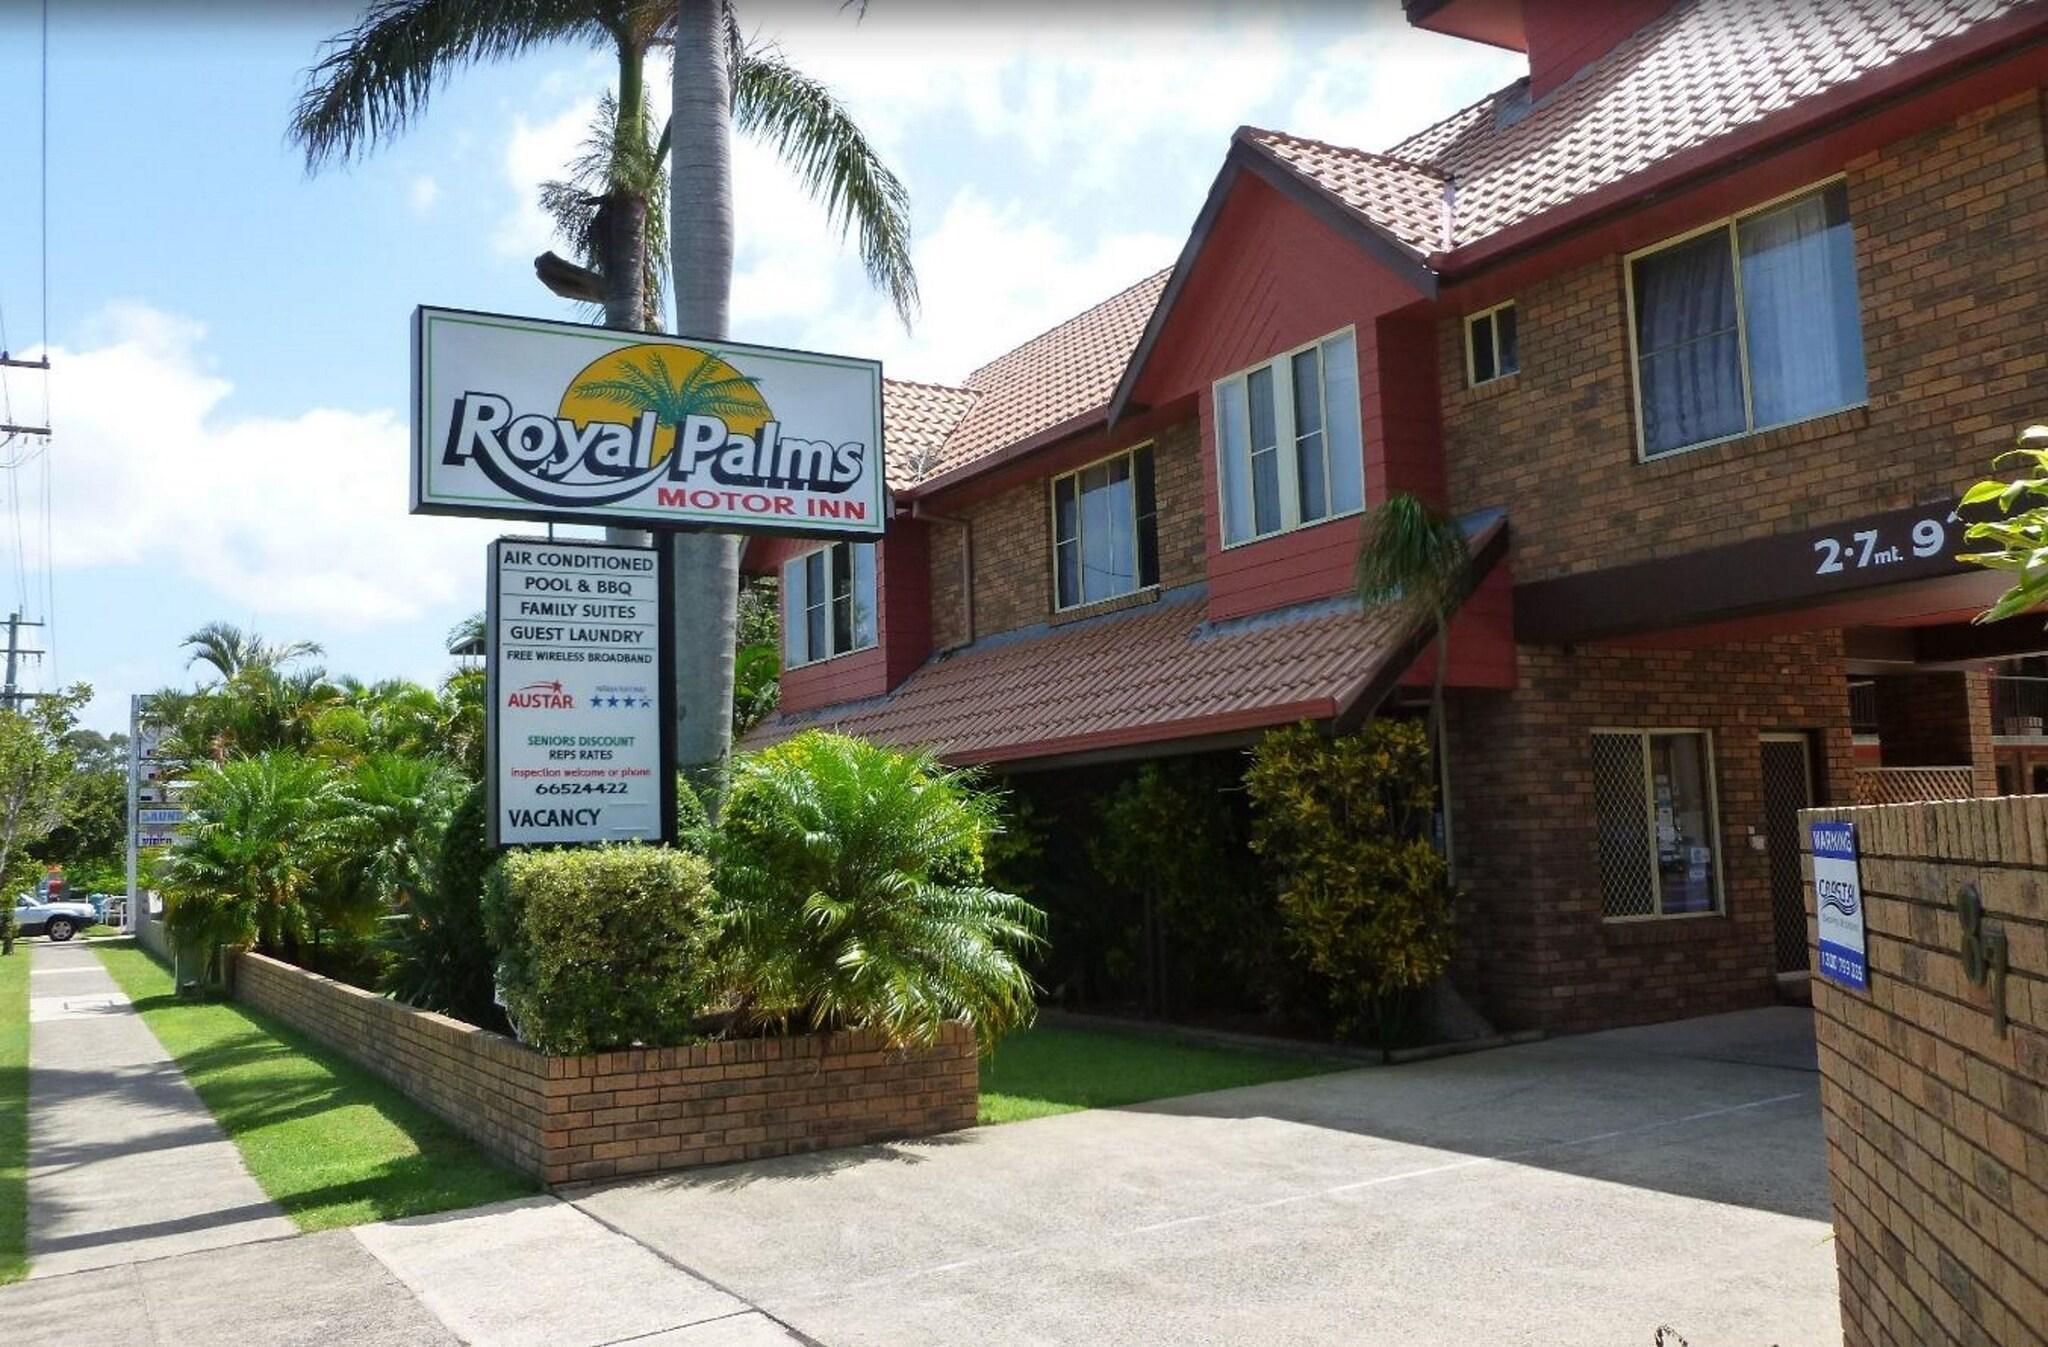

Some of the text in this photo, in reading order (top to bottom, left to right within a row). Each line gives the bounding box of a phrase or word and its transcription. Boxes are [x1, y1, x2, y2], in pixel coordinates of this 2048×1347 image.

[443, 391, 865, 505] Royal Palms
[658, 487, 866, 519] MOTOR INN
[504, 551, 653, 571] AIR CONDITIONED
[525, 577, 632, 596] POOL & BBQ
[521, 602, 636, 619] FAMILY SUITES
[511, 626, 644, 643] GUEST LAUNDRY
[507, 650, 652, 664] FREE WIRELESS BROADBAND
[508, 693, 574, 709] AUSTAR
[528, 736, 636, 747] SENIORS DISCOUNT
[549, 750, 613, 760] REPS RATES
[564, 767, 605, 777] welcome
[608, 769, 619, 777] or
[621, 767, 651, 778] phone
[508, 808, 602, 828] VACANCY
